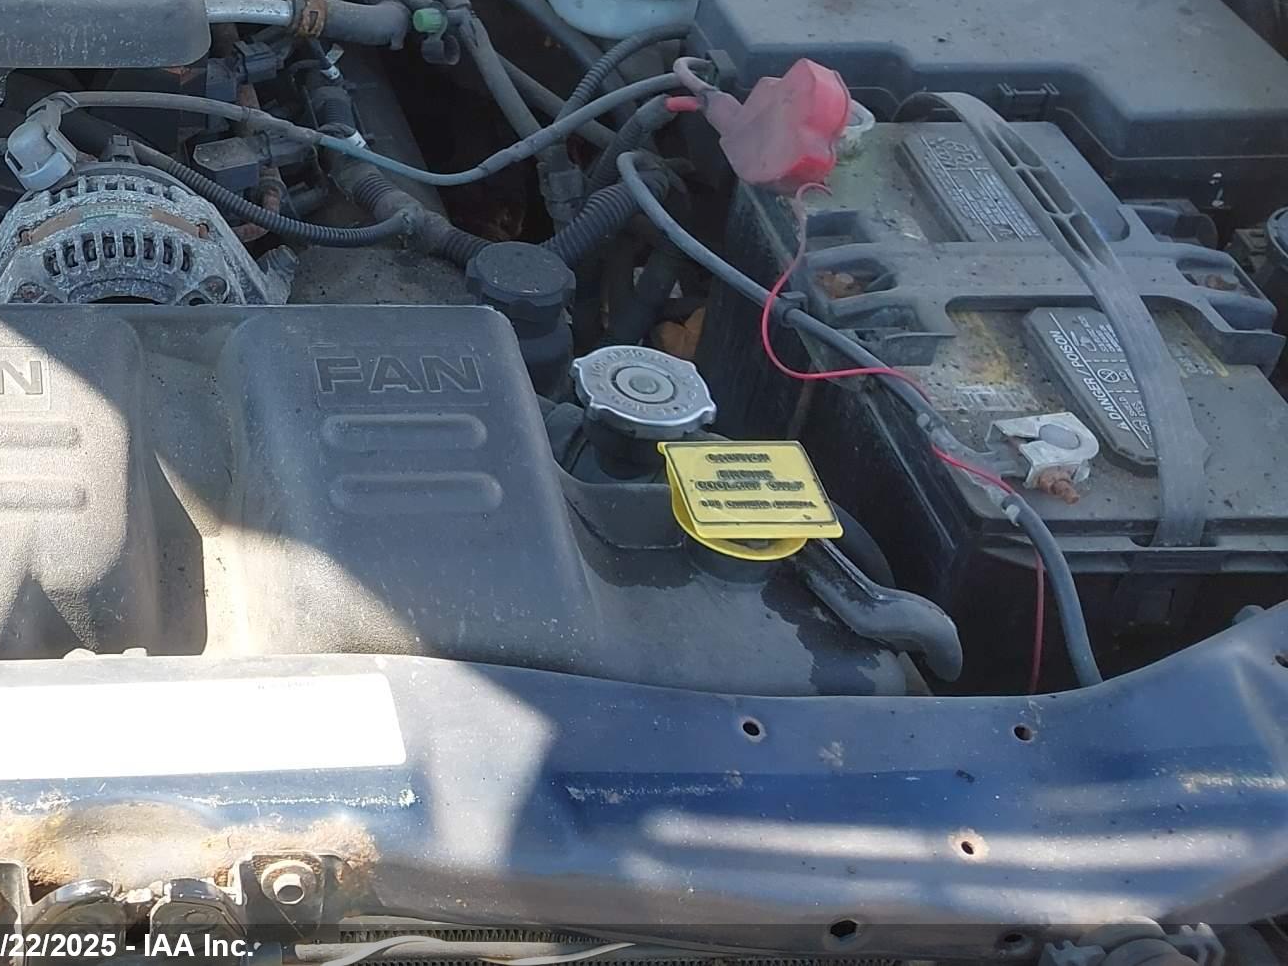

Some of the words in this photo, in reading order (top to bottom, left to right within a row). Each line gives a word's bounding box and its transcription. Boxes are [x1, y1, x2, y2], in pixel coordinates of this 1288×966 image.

[1048, 330, 1084, 367] POISON
[314, 355, 484, 394] FAN
[1083, 377, 1123, 421] DANGER
